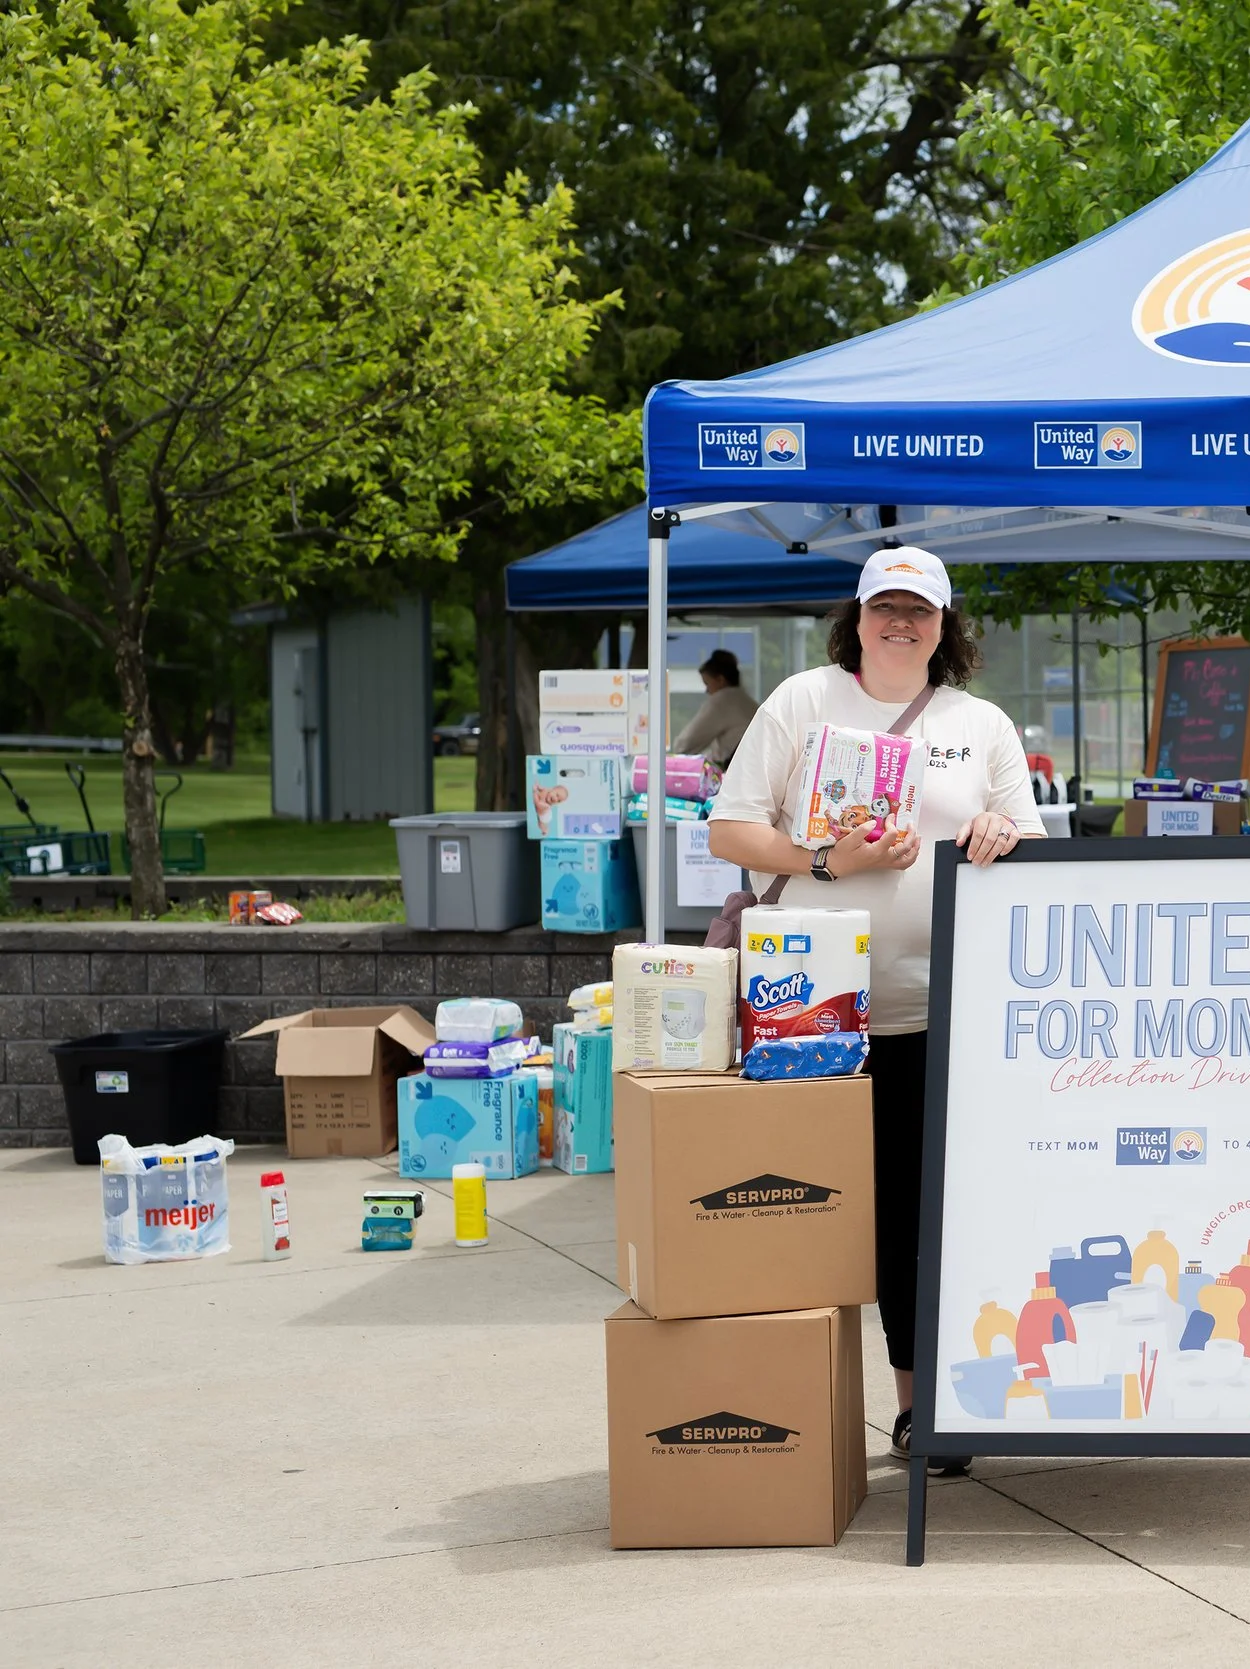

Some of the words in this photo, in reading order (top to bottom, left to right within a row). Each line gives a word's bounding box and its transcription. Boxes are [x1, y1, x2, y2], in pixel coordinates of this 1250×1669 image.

[704, 430, 758, 446] United
[1039, 428, 1094, 444] United
[853, 436, 898, 457] LIVE
[904, 435, 984, 457] UNITED
[1191, 434, 1239, 456] LIVE
[725, 446, 758, 464] Way
[1061, 444, 1094, 463] Way
[880, 745, 891, 778] pants
[926, 760, 947, 769] 025
[885, 747, 902, 793] training
[905, 785, 916, 813] meijer
[1203, 791, 1235, 801] Desitin
[1161, 811, 1199, 822] UNITED
[814, 822, 825, 835] 25
[1161, 822, 1175, 831] FOR
[1176, 823, 1199, 831] MOMS
[763, 939, 775, 954] 4
[641, 959, 695, 976] cuties
[755, 973, 805, 1008] Scott
[758, 1009, 776, 1020] Paper
[776, 1002, 798, 1014] Towels
[753, 1026, 778, 1036] Fast
[1005, 1000, 1119, 1060] FOR
[1050, 1057, 1186, 1093] Collection
[483, 1081, 493, 1108] Free
[494, 1081, 504, 1142] Fragrance
[1028, 1141, 1062, 1151] TEXT
[1067, 1140, 1099, 1151] MOM
[1119, 1131, 1168, 1145] United
[1223, 1140, 1240, 1149] TO
[1138, 1147, 1167, 1163] Way
[165, 1185, 182, 1196] APER
[145, 1199, 215, 1230] meijer
[695, 1213, 711, 1221] Fire
[712, 1212, 720, 1220] &
[721, 1211, 746, 1220] Water
[752, 1208, 784, 1219] Cleanup
[786, 1207, 793, 1216] &
[651, 1447, 666, 1455] Fire
[668, 1447, 675, 1455] &
[676, 1447, 702, 1455] Water
[707, 1446, 741, 1456] Cleanup
[742, 1446, 750, 1454] &
